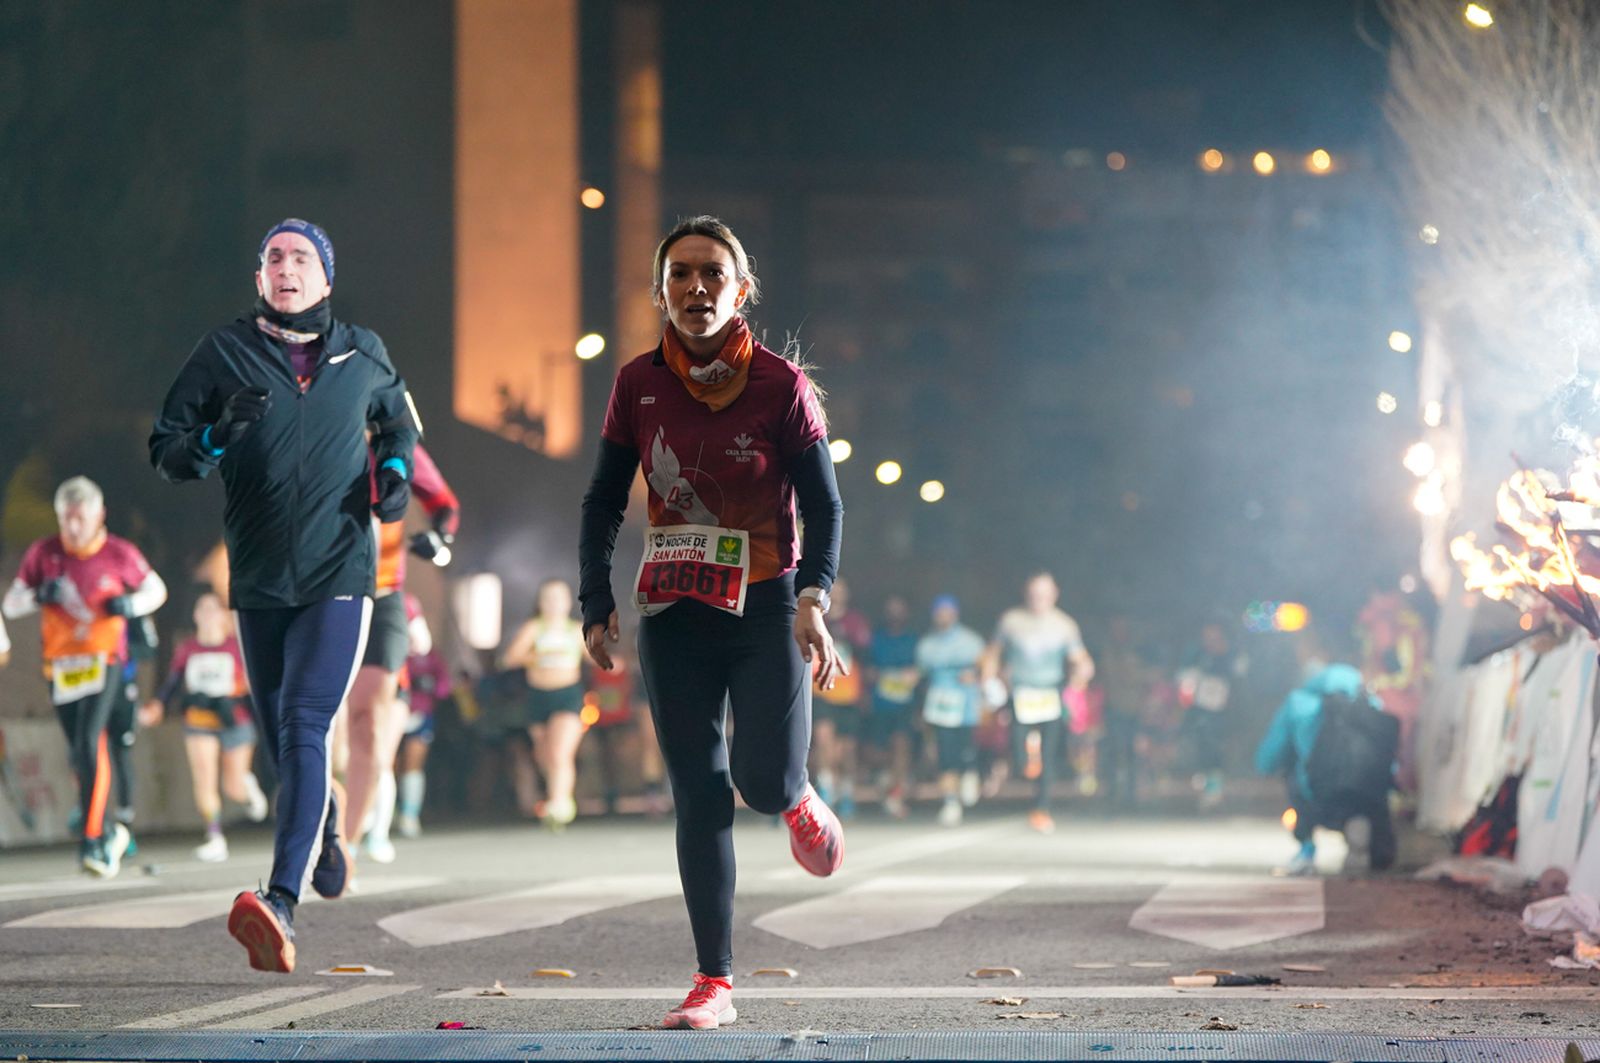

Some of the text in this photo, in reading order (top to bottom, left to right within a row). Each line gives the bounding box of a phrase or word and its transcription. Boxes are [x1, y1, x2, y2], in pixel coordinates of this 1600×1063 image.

[666, 486, 693, 511] 43
[665, 536, 692, 547] NOCHE
[693, 536, 708, 548] DE
[652, 550, 671, 561] SAN
[671, 547, 706, 561] ANTÓN
[651, 561, 730, 597] 13661
